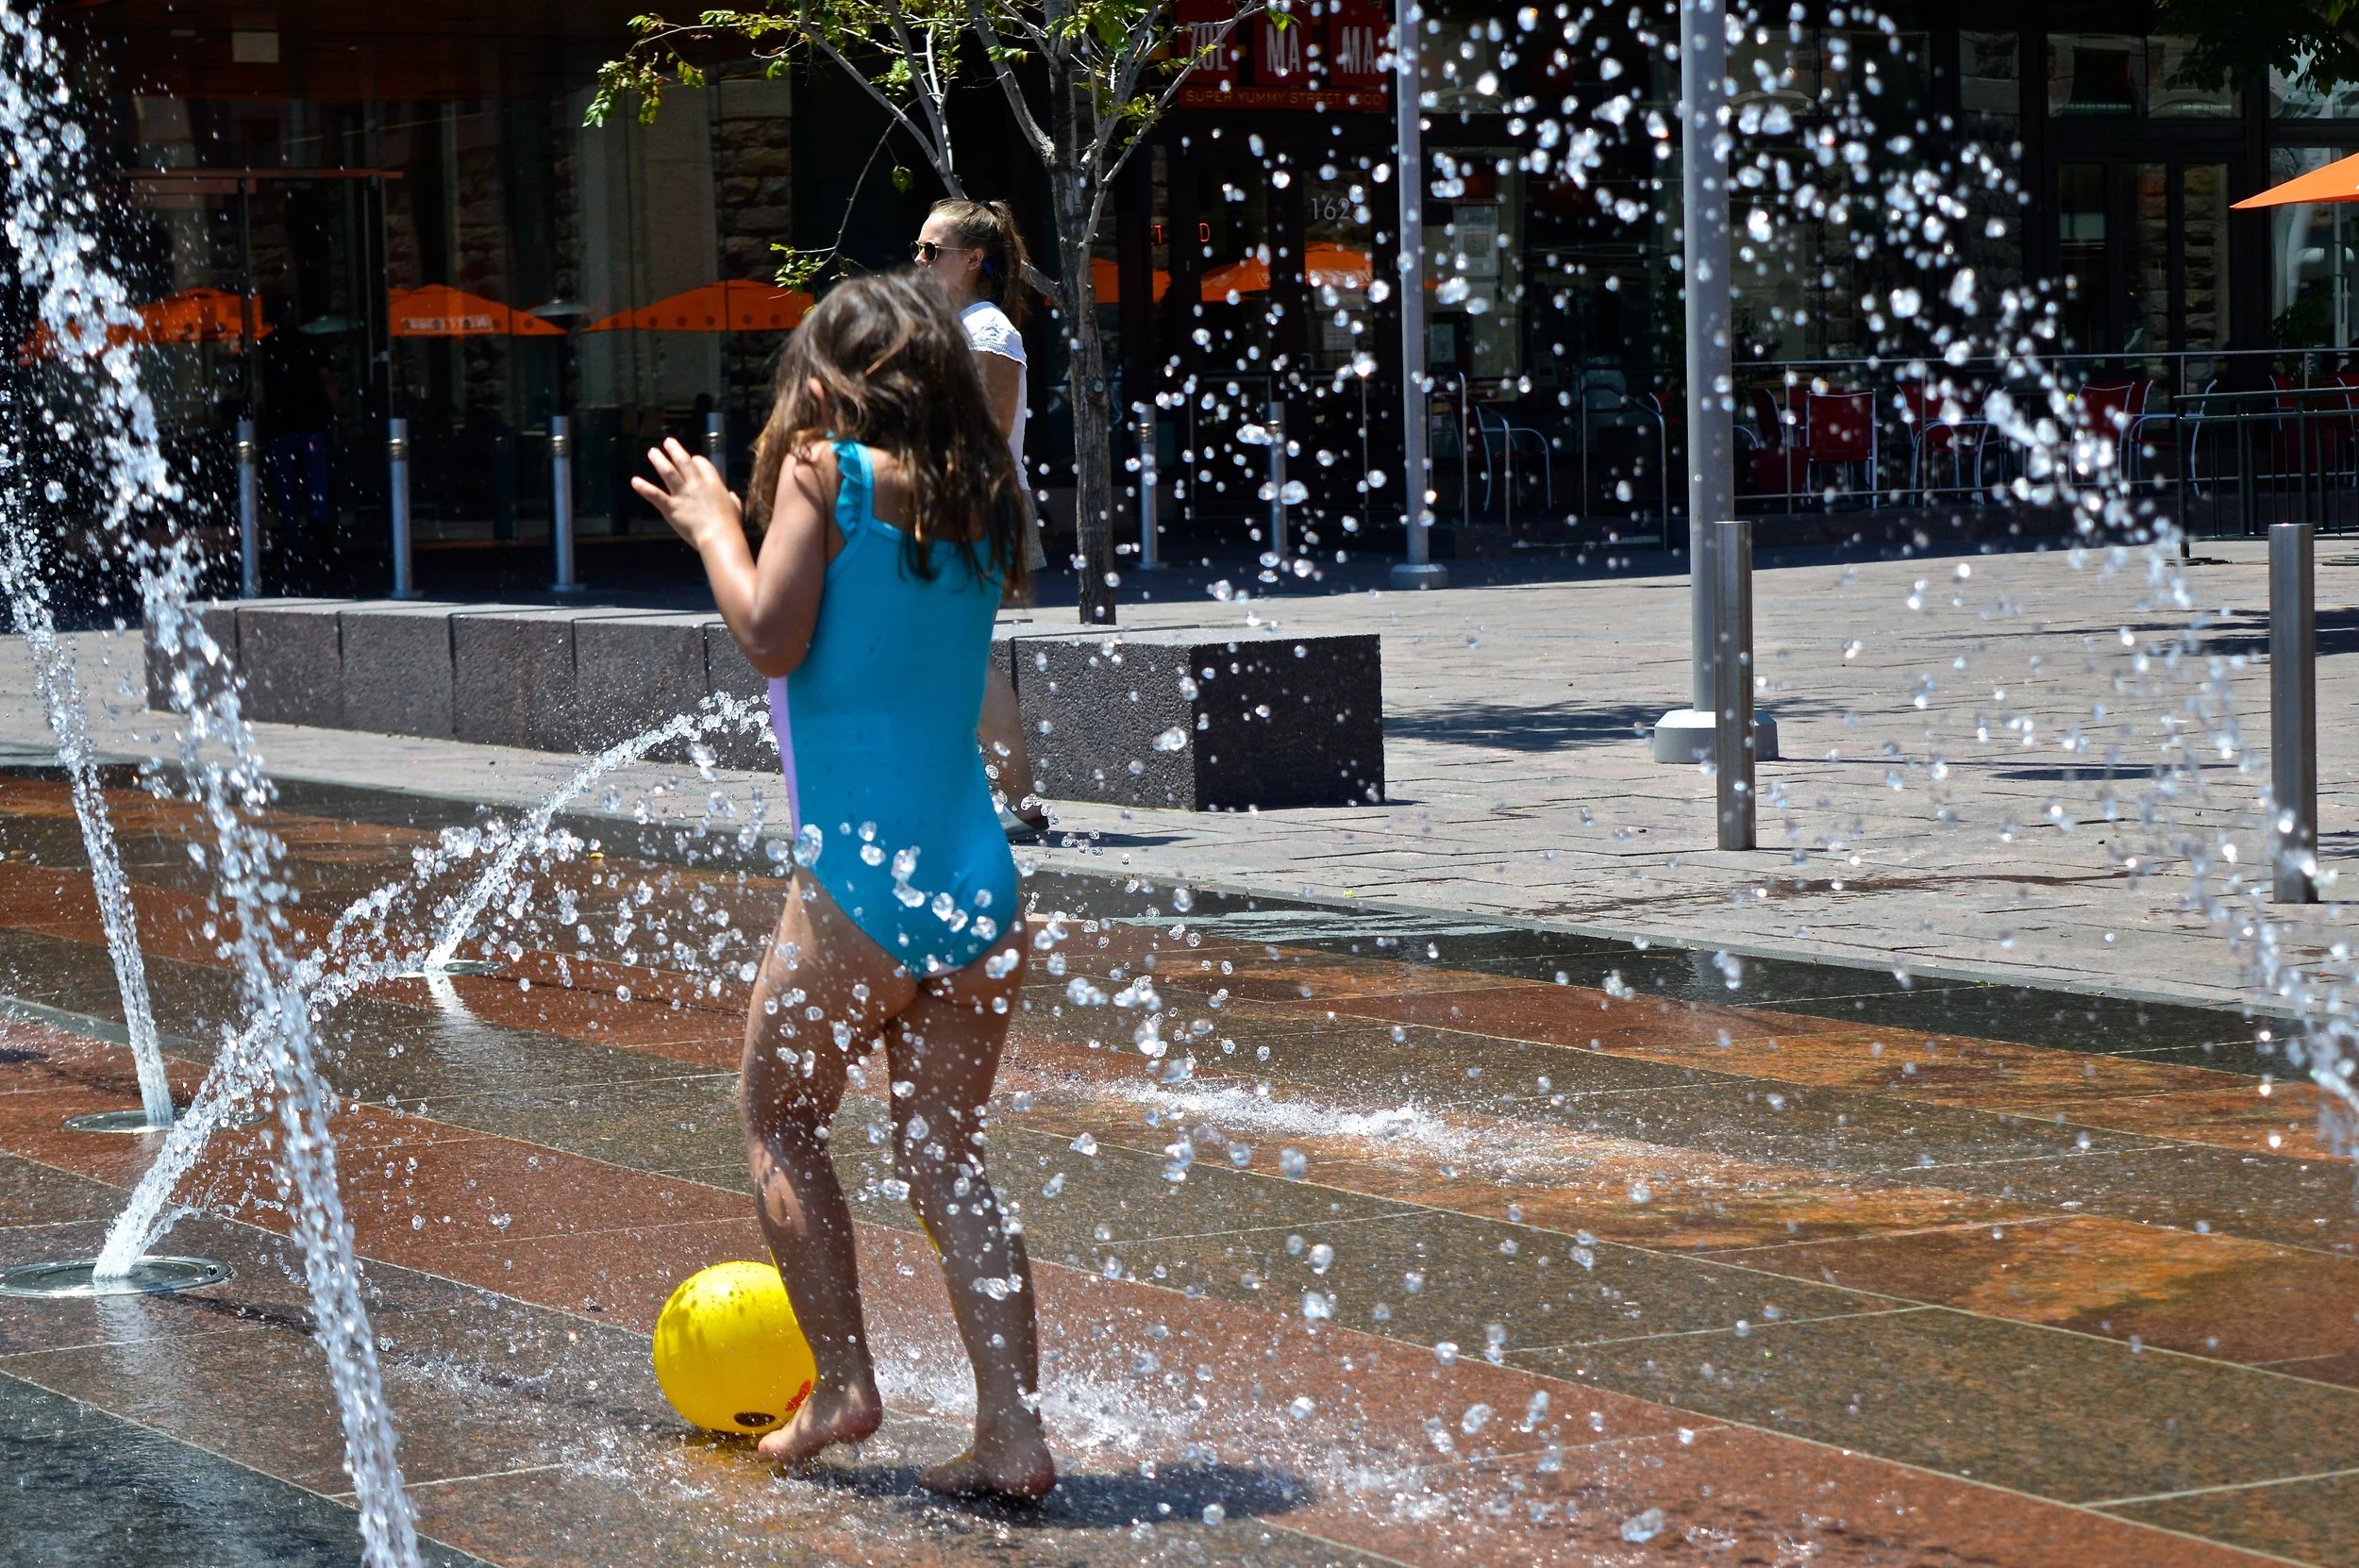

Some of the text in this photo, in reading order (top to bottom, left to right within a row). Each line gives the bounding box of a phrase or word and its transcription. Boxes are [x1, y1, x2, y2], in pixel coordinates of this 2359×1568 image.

[1265, 24, 1301, 73] MA
[1341, 25, 1377, 75] MA
[1185, 90, 1232, 103] SUPER
[1237, 92, 1287, 104] YUMMY
[1290, 92, 1341, 105] STREET
